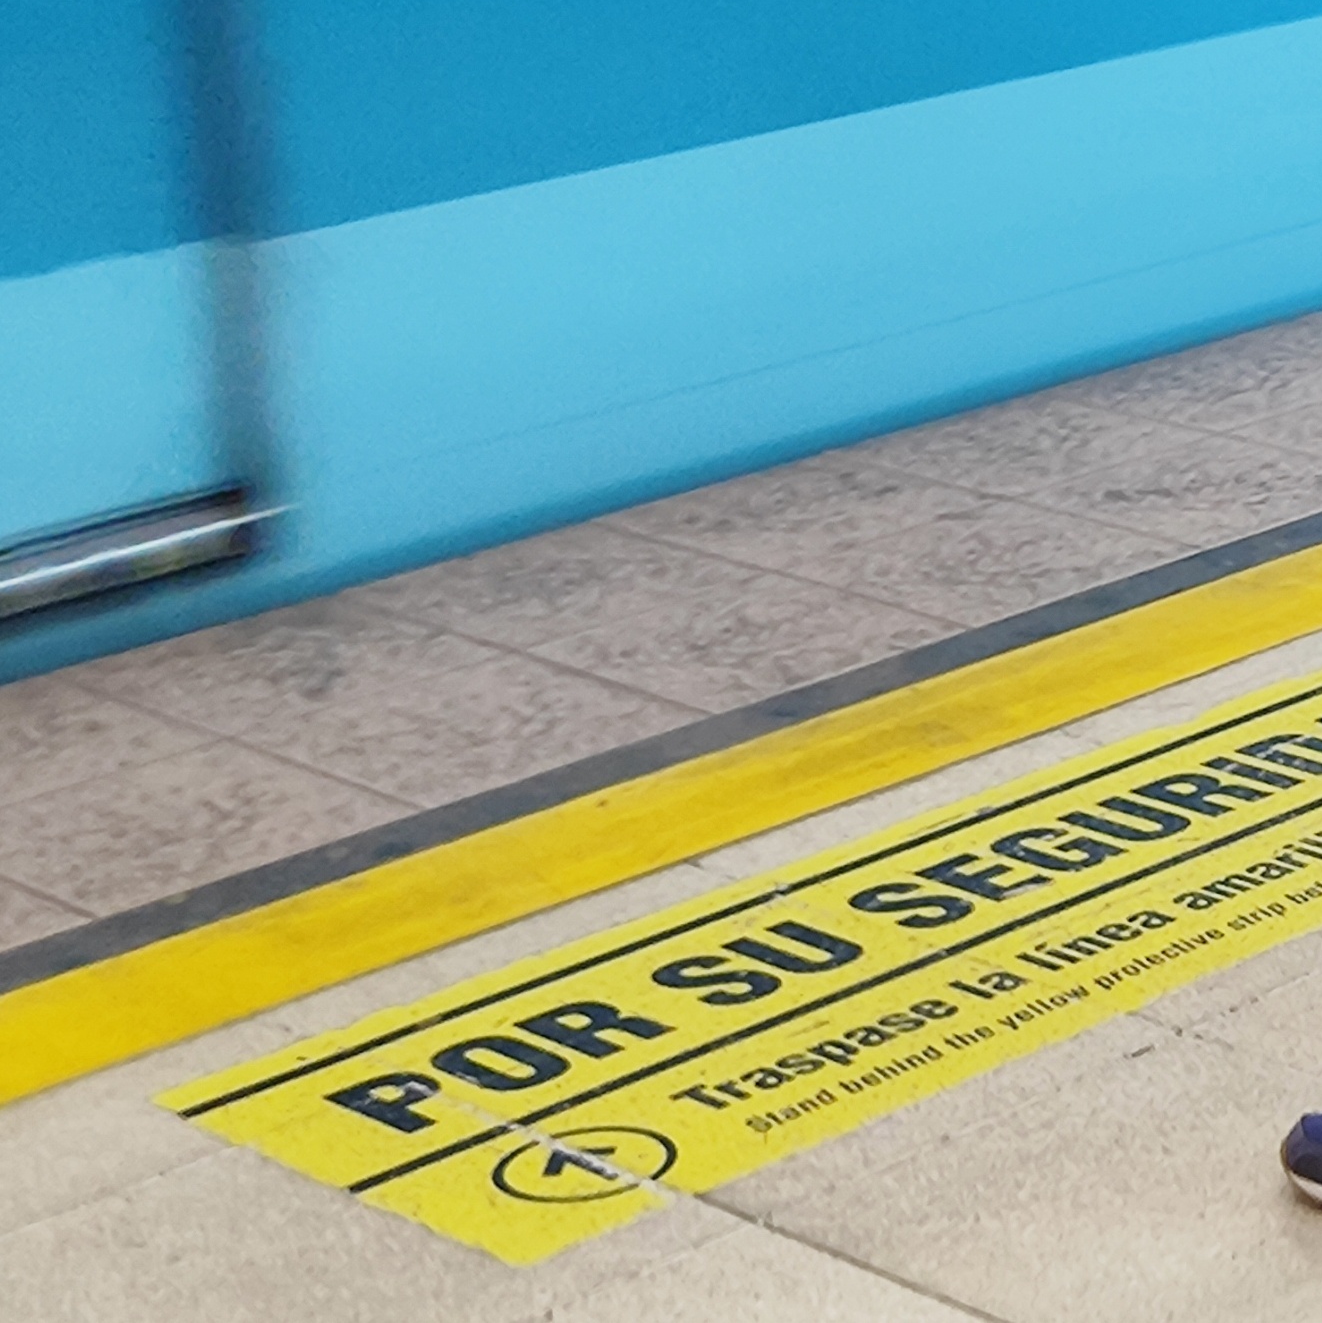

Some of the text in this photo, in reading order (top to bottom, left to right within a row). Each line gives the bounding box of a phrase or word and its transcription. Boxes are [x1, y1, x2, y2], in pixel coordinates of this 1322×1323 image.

[323, 1000, 678, 1134] POR
[651, 919, 864, 1006] SU
[668, 999, 959, 1110] Traspase
[948, 971, 1031, 1000] la
[1015, 911, 1177, 972] línea
[745, 1088, 838, 1133] Stand
[839, 1045, 944, 1095] behind
[943, 1026, 995, 1050] the
[997, 985, 1090, 1030] yellow
[1093, 928, 1225, 991] protective
[1226, 900, 1287, 933] strip
